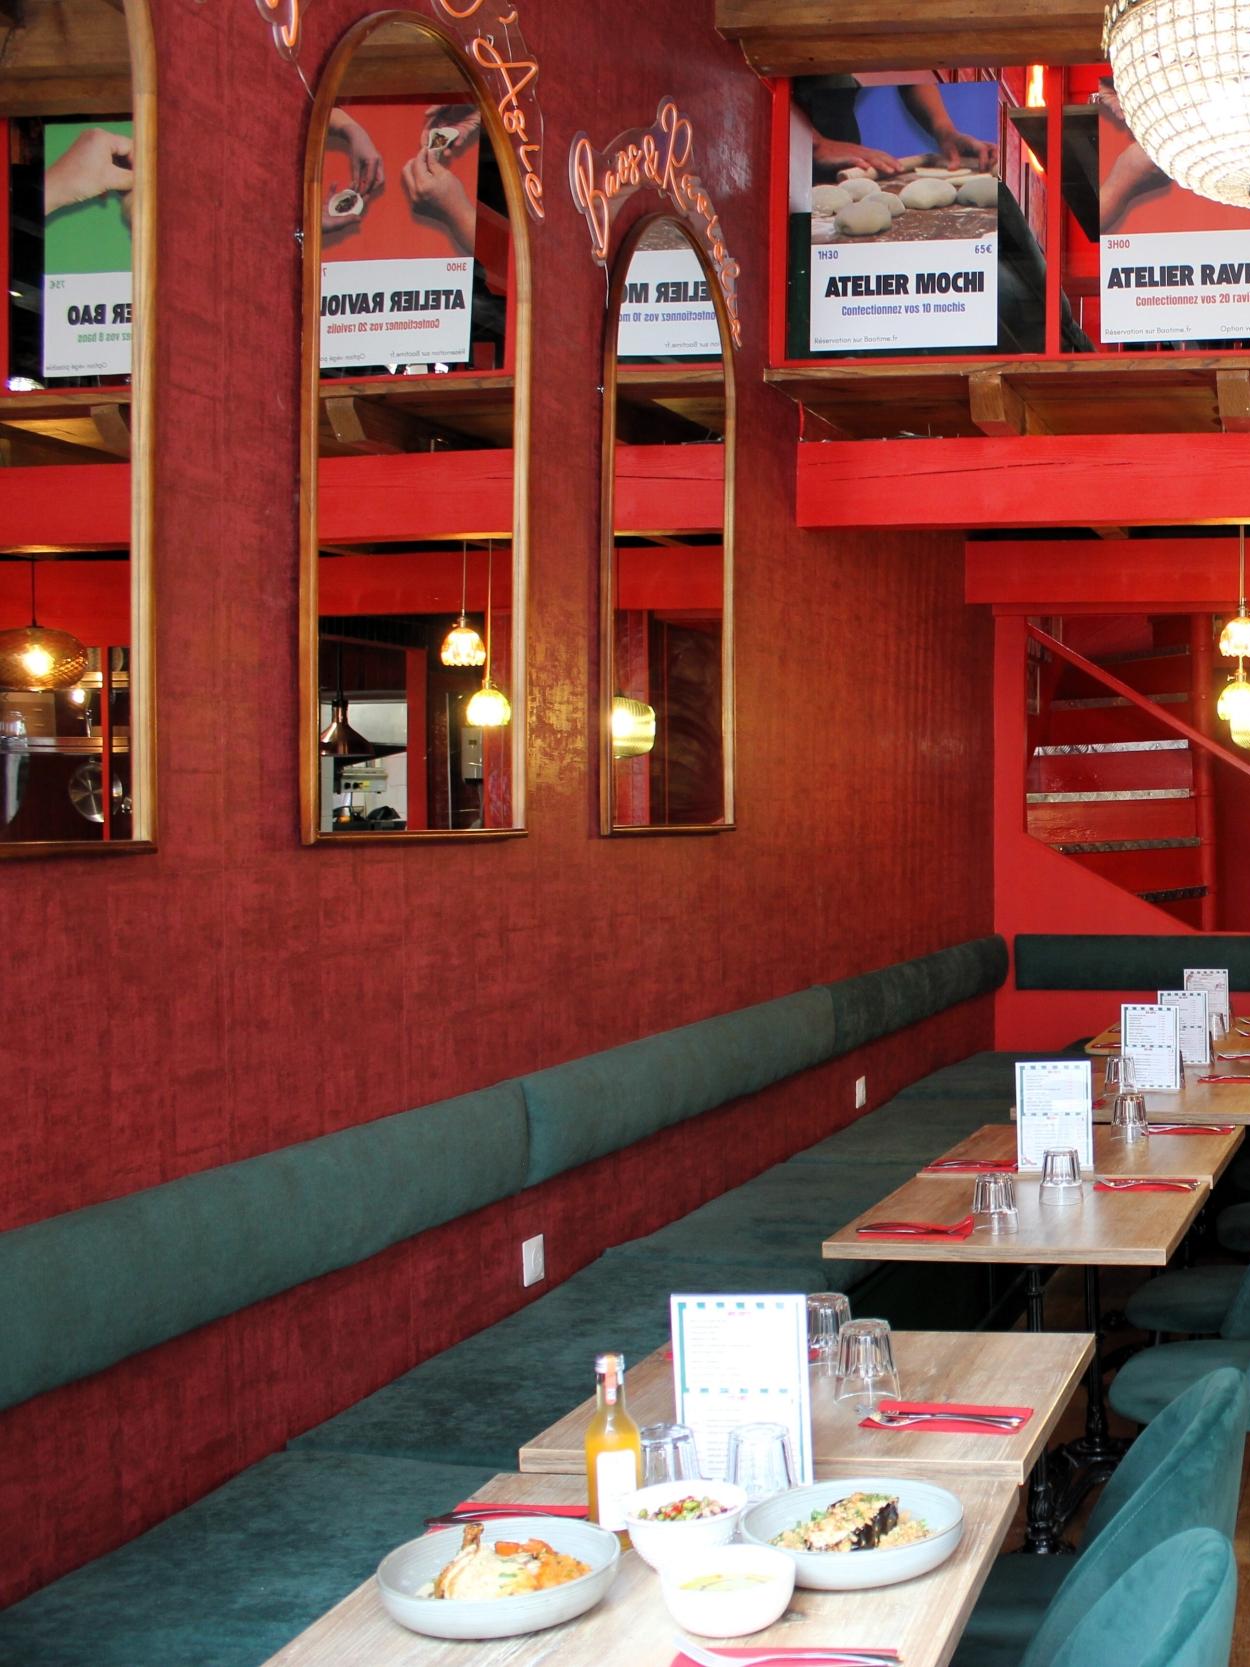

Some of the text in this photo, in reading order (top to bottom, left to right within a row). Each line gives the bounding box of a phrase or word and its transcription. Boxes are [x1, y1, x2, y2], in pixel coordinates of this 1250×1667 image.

[643, 134, 663, 187] &
[974, 244, 992, 254] 65€
[1107, 239, 1130, 249] 3H00
[818, 250, 839, 260] 1H30
[1107, 265, 1194, 289] ATELIER
[824, 271, 984, 298] ATELIER MOCHI
[1136, 295, 1198, 307] Confectionnez
[1200, 295, 1216, 304] vos
[1219, 293, 1230, 303] 20
[842, 301, 965, 316] Confectionnez vos 10 mochis
